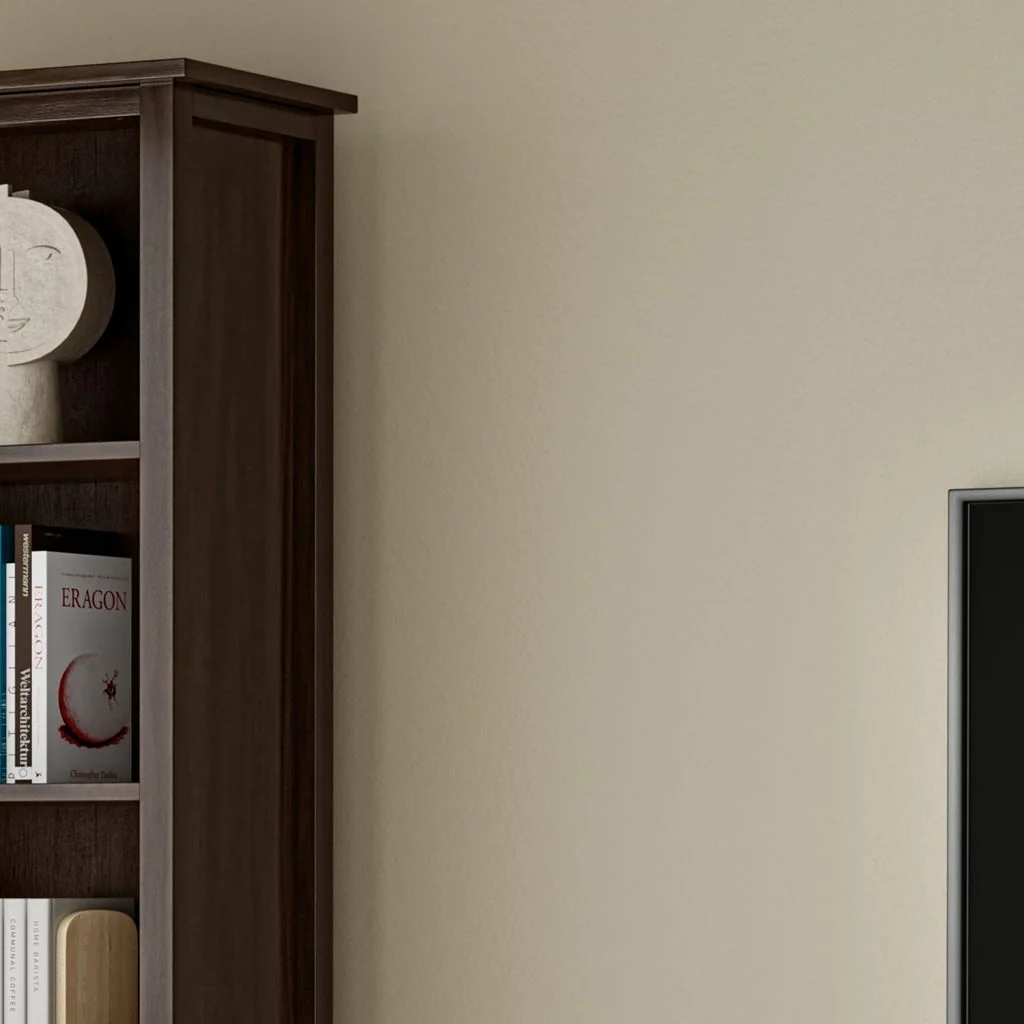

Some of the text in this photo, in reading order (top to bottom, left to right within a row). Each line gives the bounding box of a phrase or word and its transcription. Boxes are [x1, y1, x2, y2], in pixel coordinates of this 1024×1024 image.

[22, 533, 30, 598] westermann
[62, 587, 128, 611] ERAGON
[34, 585, 44, 670] ERAGON
[19, 668, 31, 768] Weltarchitektur
[9, 918, 17, 1013] COMMUNAL COFFEE
